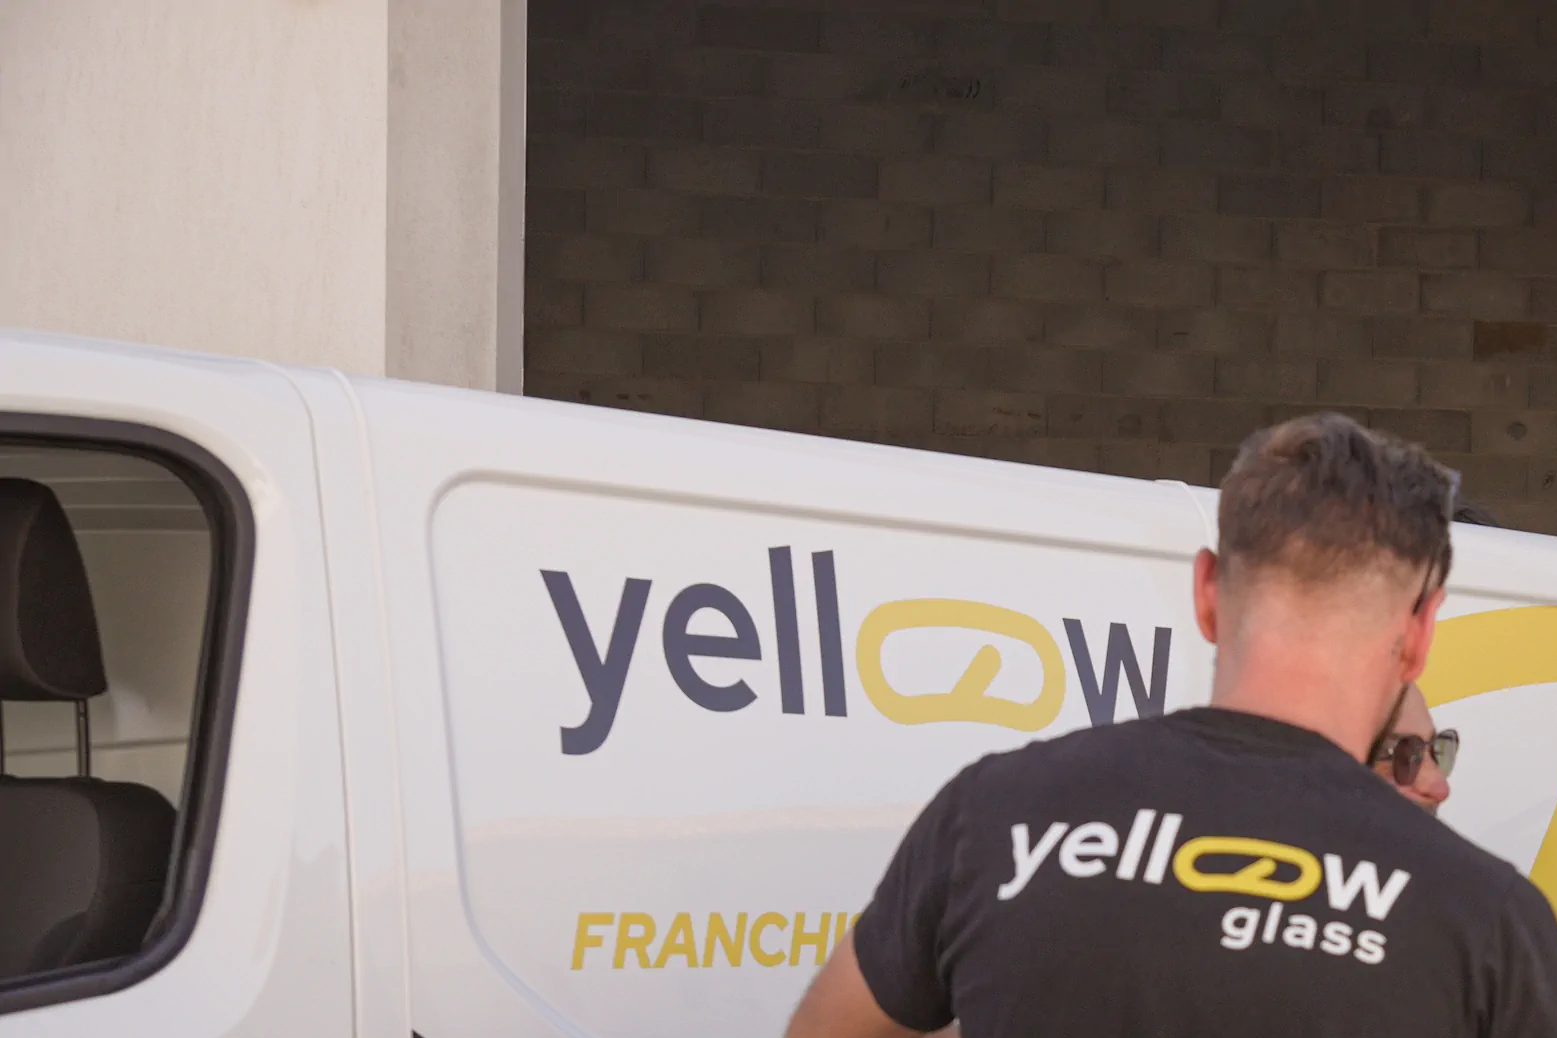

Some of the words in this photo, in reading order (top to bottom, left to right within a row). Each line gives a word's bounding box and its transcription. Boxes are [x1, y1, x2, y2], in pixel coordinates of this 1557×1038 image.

[539, 546, 1172, 755] yellow
[998, 808, 1411, 921] yellow
[571, 911, 862, 970] FRANCHI
[1220, 902, 1387, 965] glass
